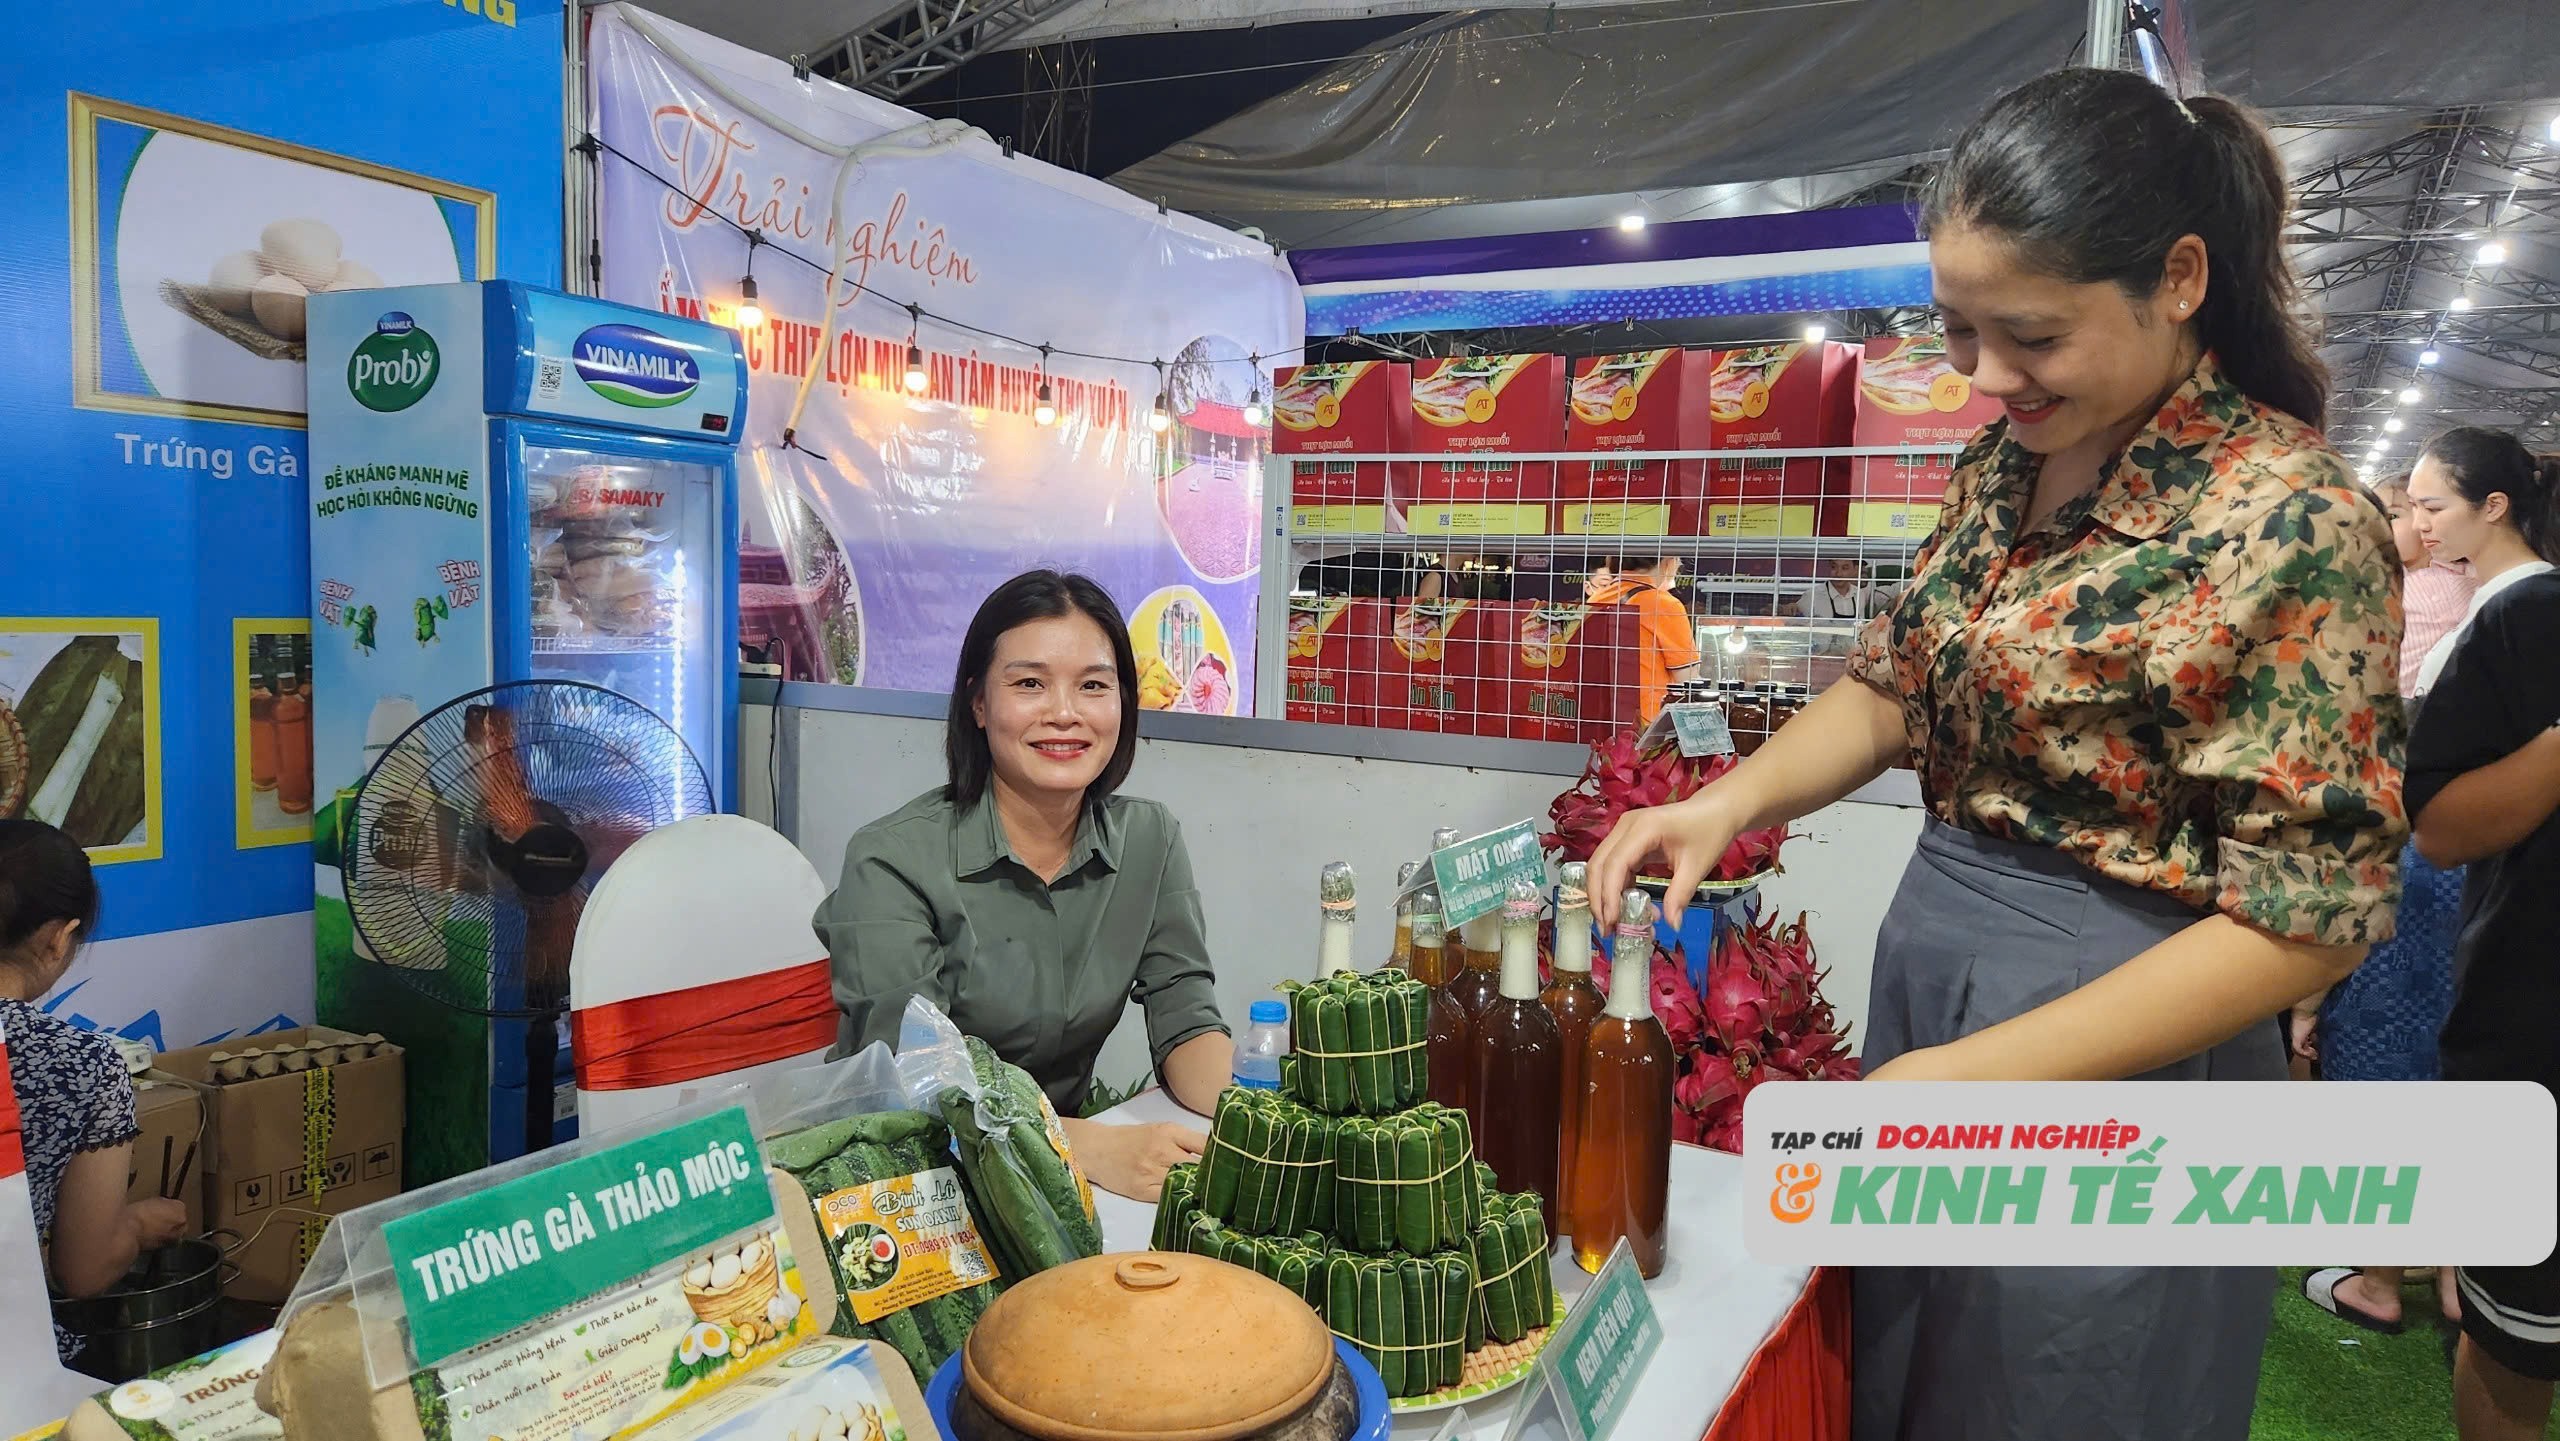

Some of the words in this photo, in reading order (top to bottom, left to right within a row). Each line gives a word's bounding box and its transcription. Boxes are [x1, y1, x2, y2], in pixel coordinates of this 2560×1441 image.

[653, 105, 812, 239] Trải
[380, 320, 412, 330] VINAMILK
[355, 348, 434, 391] Proby
[585, 343, 691, 384] VINAMILK
[827, 329, 867, 397] LỢN
[929, 351, 953, 400] AN
[959, 350, 994, 409] TÂM
[1475, 398, 1490, 410] AT
[115, 433, 233, 479] Trứng
[248, 445, 299, 477] Gà
[346, 463, 396, 485] KHÁNG
[400, 465, 443, 487] MẠNH
[445, 470, 469, 491] MẼ
[316, 496, 345, 518] HỌC
[373, 486, 421, 507] KHÔNG
[424, 493, 479, 519] NGỪNG
[599, 488, 665, 508] SANAKY
[437, 560, 481, 585] BỆNH
[1528, 690, 1545, 714] An
[1549, 693, 1576, 719] Tâm
[1456, 847, 1490, 881] MẬT
[872, 1183, 926, 1216] Bánh
[412, 1218, 542, 1303] TRỨNG
[544, 1191, 596, 1253] GÀ
[594, 1160, 681, 1232] THẢO
[681, 1140, 752, 1200] MỘC
[922, 1205, 961, 1228] OANH
[941, 1234, 959, 1250] 811
[590, 1316, 611, 1332] Thức
[613, 1311, 625, 1321] ăn
[627, 1303, 642, 1316] bản
[516, 1345, 544, 1367] phòng
[545, 1335, 567, 1350] bệnh
[597, 1343, 619, 1359] Giàu
[620, 1324, 661, 1349] Omega-3
[1575, 1335, 1602, 1389] NEM
[181, 1367, 260, 1404] TRỨNG
[475, 1399, 501, 1415] Chăn
[504, 1385, 523, 1403] nuôi
[526, 1382, 538, 1393] an
[540, 1369, 562, 1386] toàn
[582, 1381, 592, 1392] có
